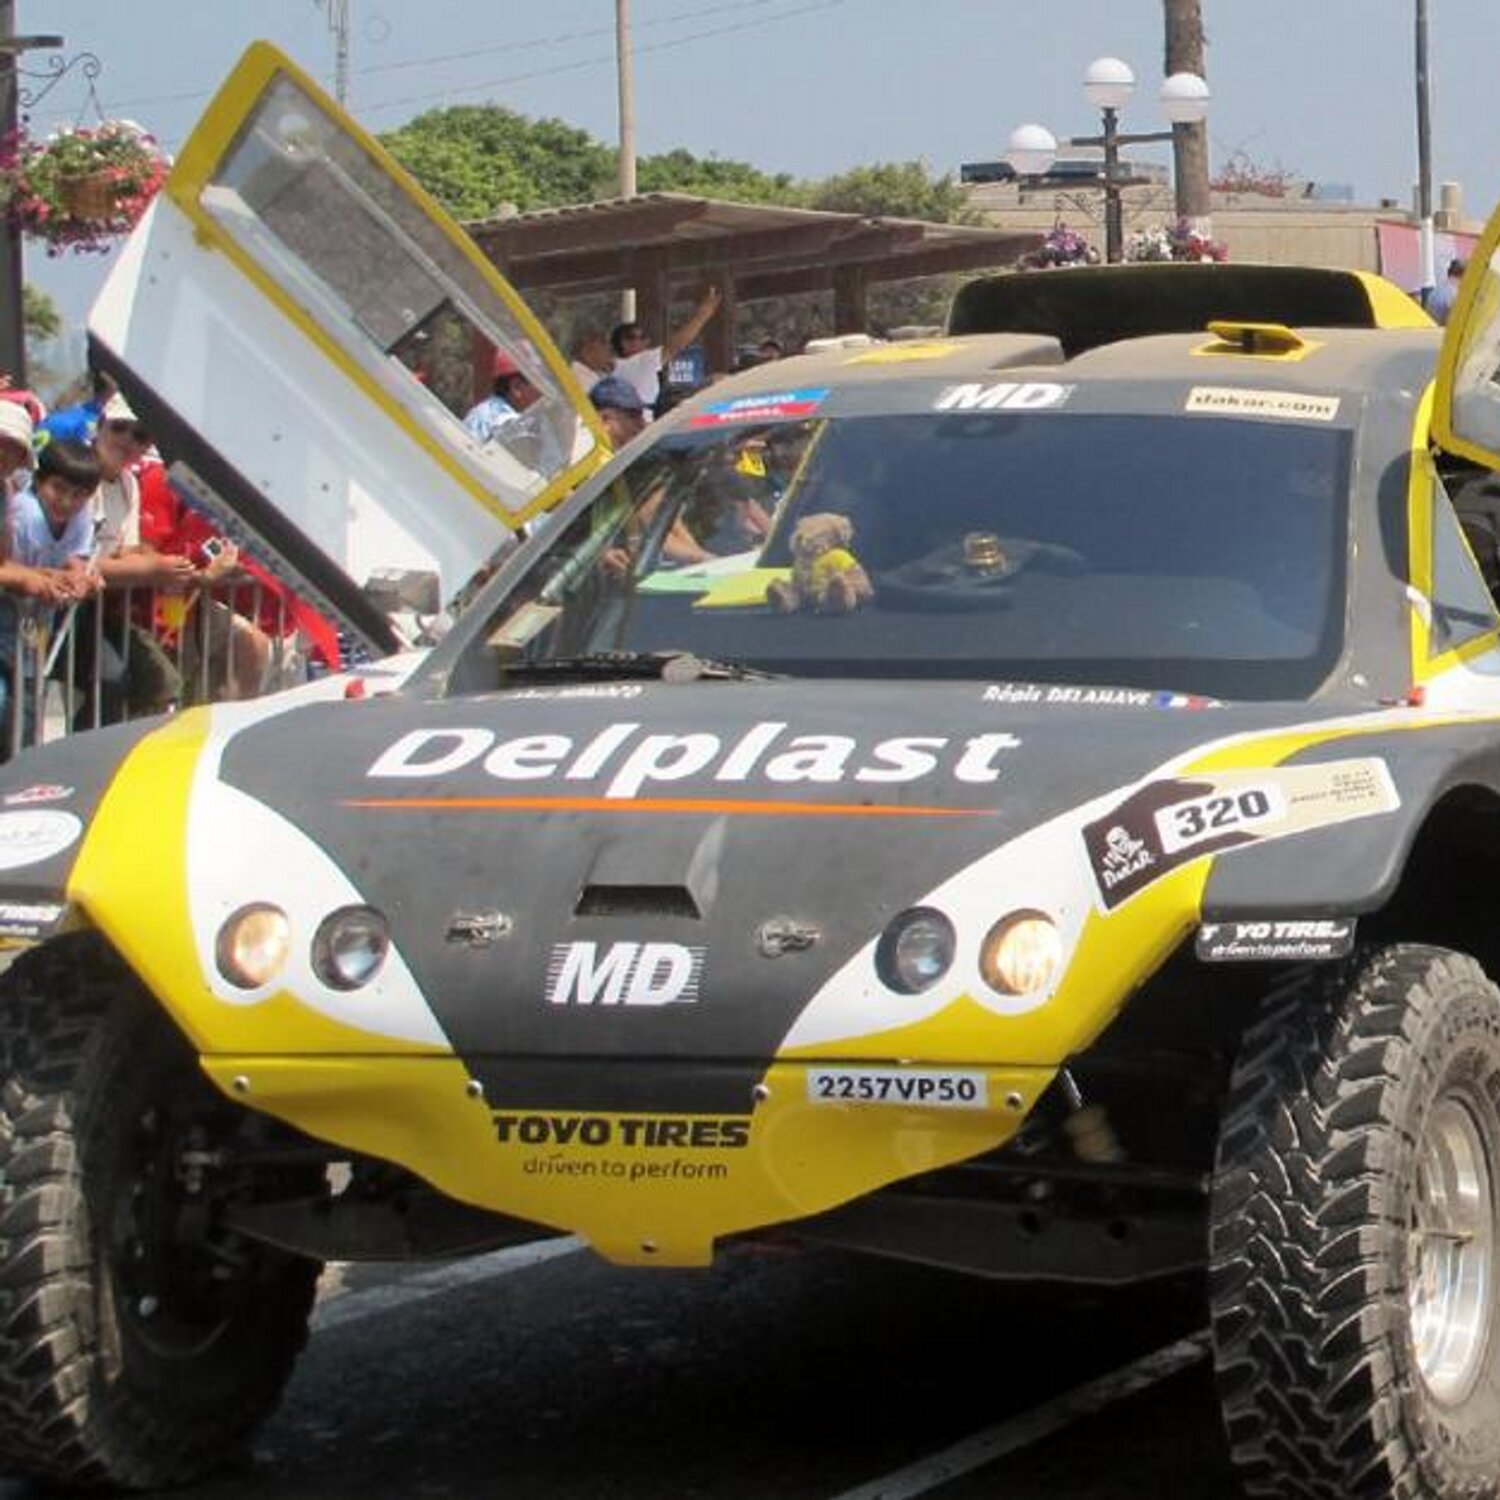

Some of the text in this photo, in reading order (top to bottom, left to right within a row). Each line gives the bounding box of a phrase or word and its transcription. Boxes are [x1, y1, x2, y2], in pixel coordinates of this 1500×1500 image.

[936, 383, 1075, 411] MD
[366, 723, 1021, 798] Delplast
[1174, 789, 1271, 840] 320
[547, 942, 706, 1005] MD
[817, 1075, 978, 1102] 2257VP50
[493, 1116, 750, 1148] TOYO TIRES
[522, 1153, 728, 1182] driven to perform
